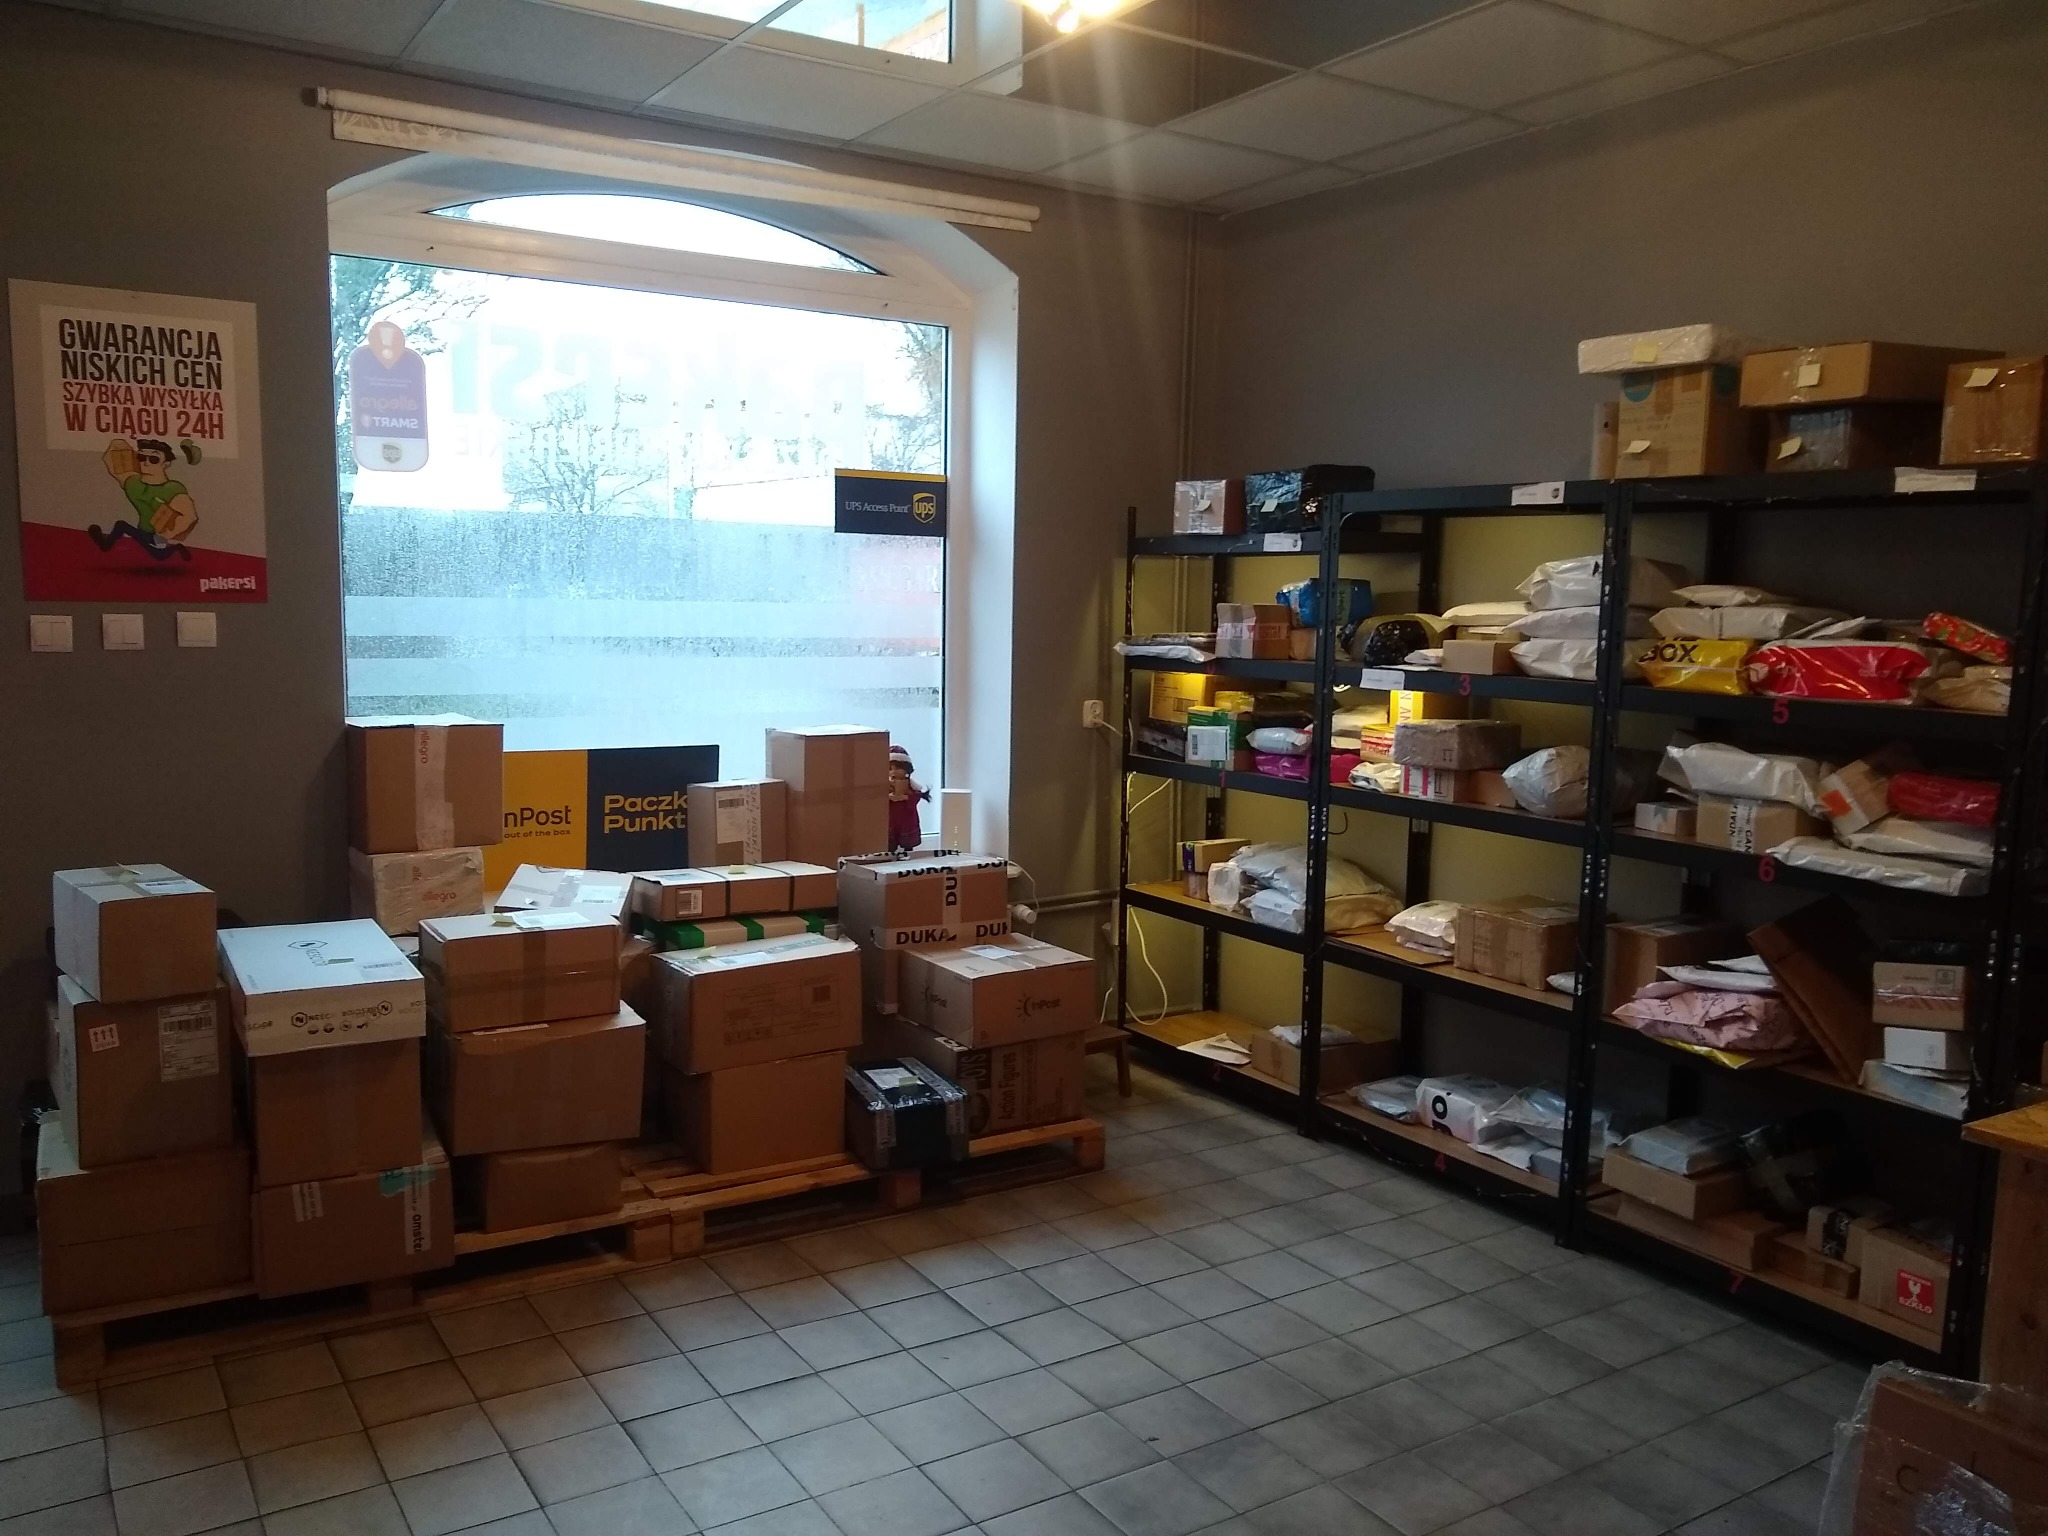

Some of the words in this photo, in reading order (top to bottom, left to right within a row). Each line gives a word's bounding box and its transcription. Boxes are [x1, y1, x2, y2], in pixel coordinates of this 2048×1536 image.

[60, 319, 222, 361] GWARANCJA
[62, 350, 166, 386] NISKICH
[174, 356, 222, 390] CEN
[64, 381, 135, 406] SZYBKA
[139, 387, 224, 411] WYSYŁKA
[65, 403, 88, 432] W
[96, 406, 168, 440] CIĄGU
[177, 411, 224, 440] 24H
[845, 501, 862, 511] UPS
[864, 503, 888, 513] Access
[200, 576, 256, 593] pakersi
[1458, 673, 1471, 696] 3
[1772, 699, 1790, 725] 5
[604, 791, 688, 814] Paczk
[503, 805, 571, 828] nPost
[604, 812, 686, 834] Punkt
[503, 831, 520, 839] out
[522, 830, 533, 838] of
[535, 829, 551, 837] the
[553, 828, 571, 836] box
[1758, 856, 1776, 883] 6
[896, 927, 958, 945] DUKA
[998, 1052, 1020, 1088] Figures
[998, 1090, 1017, 1120] Action
[1433, 1152, 1449, 1175] 4
[1728, 1270, 1746, 1296] 7
